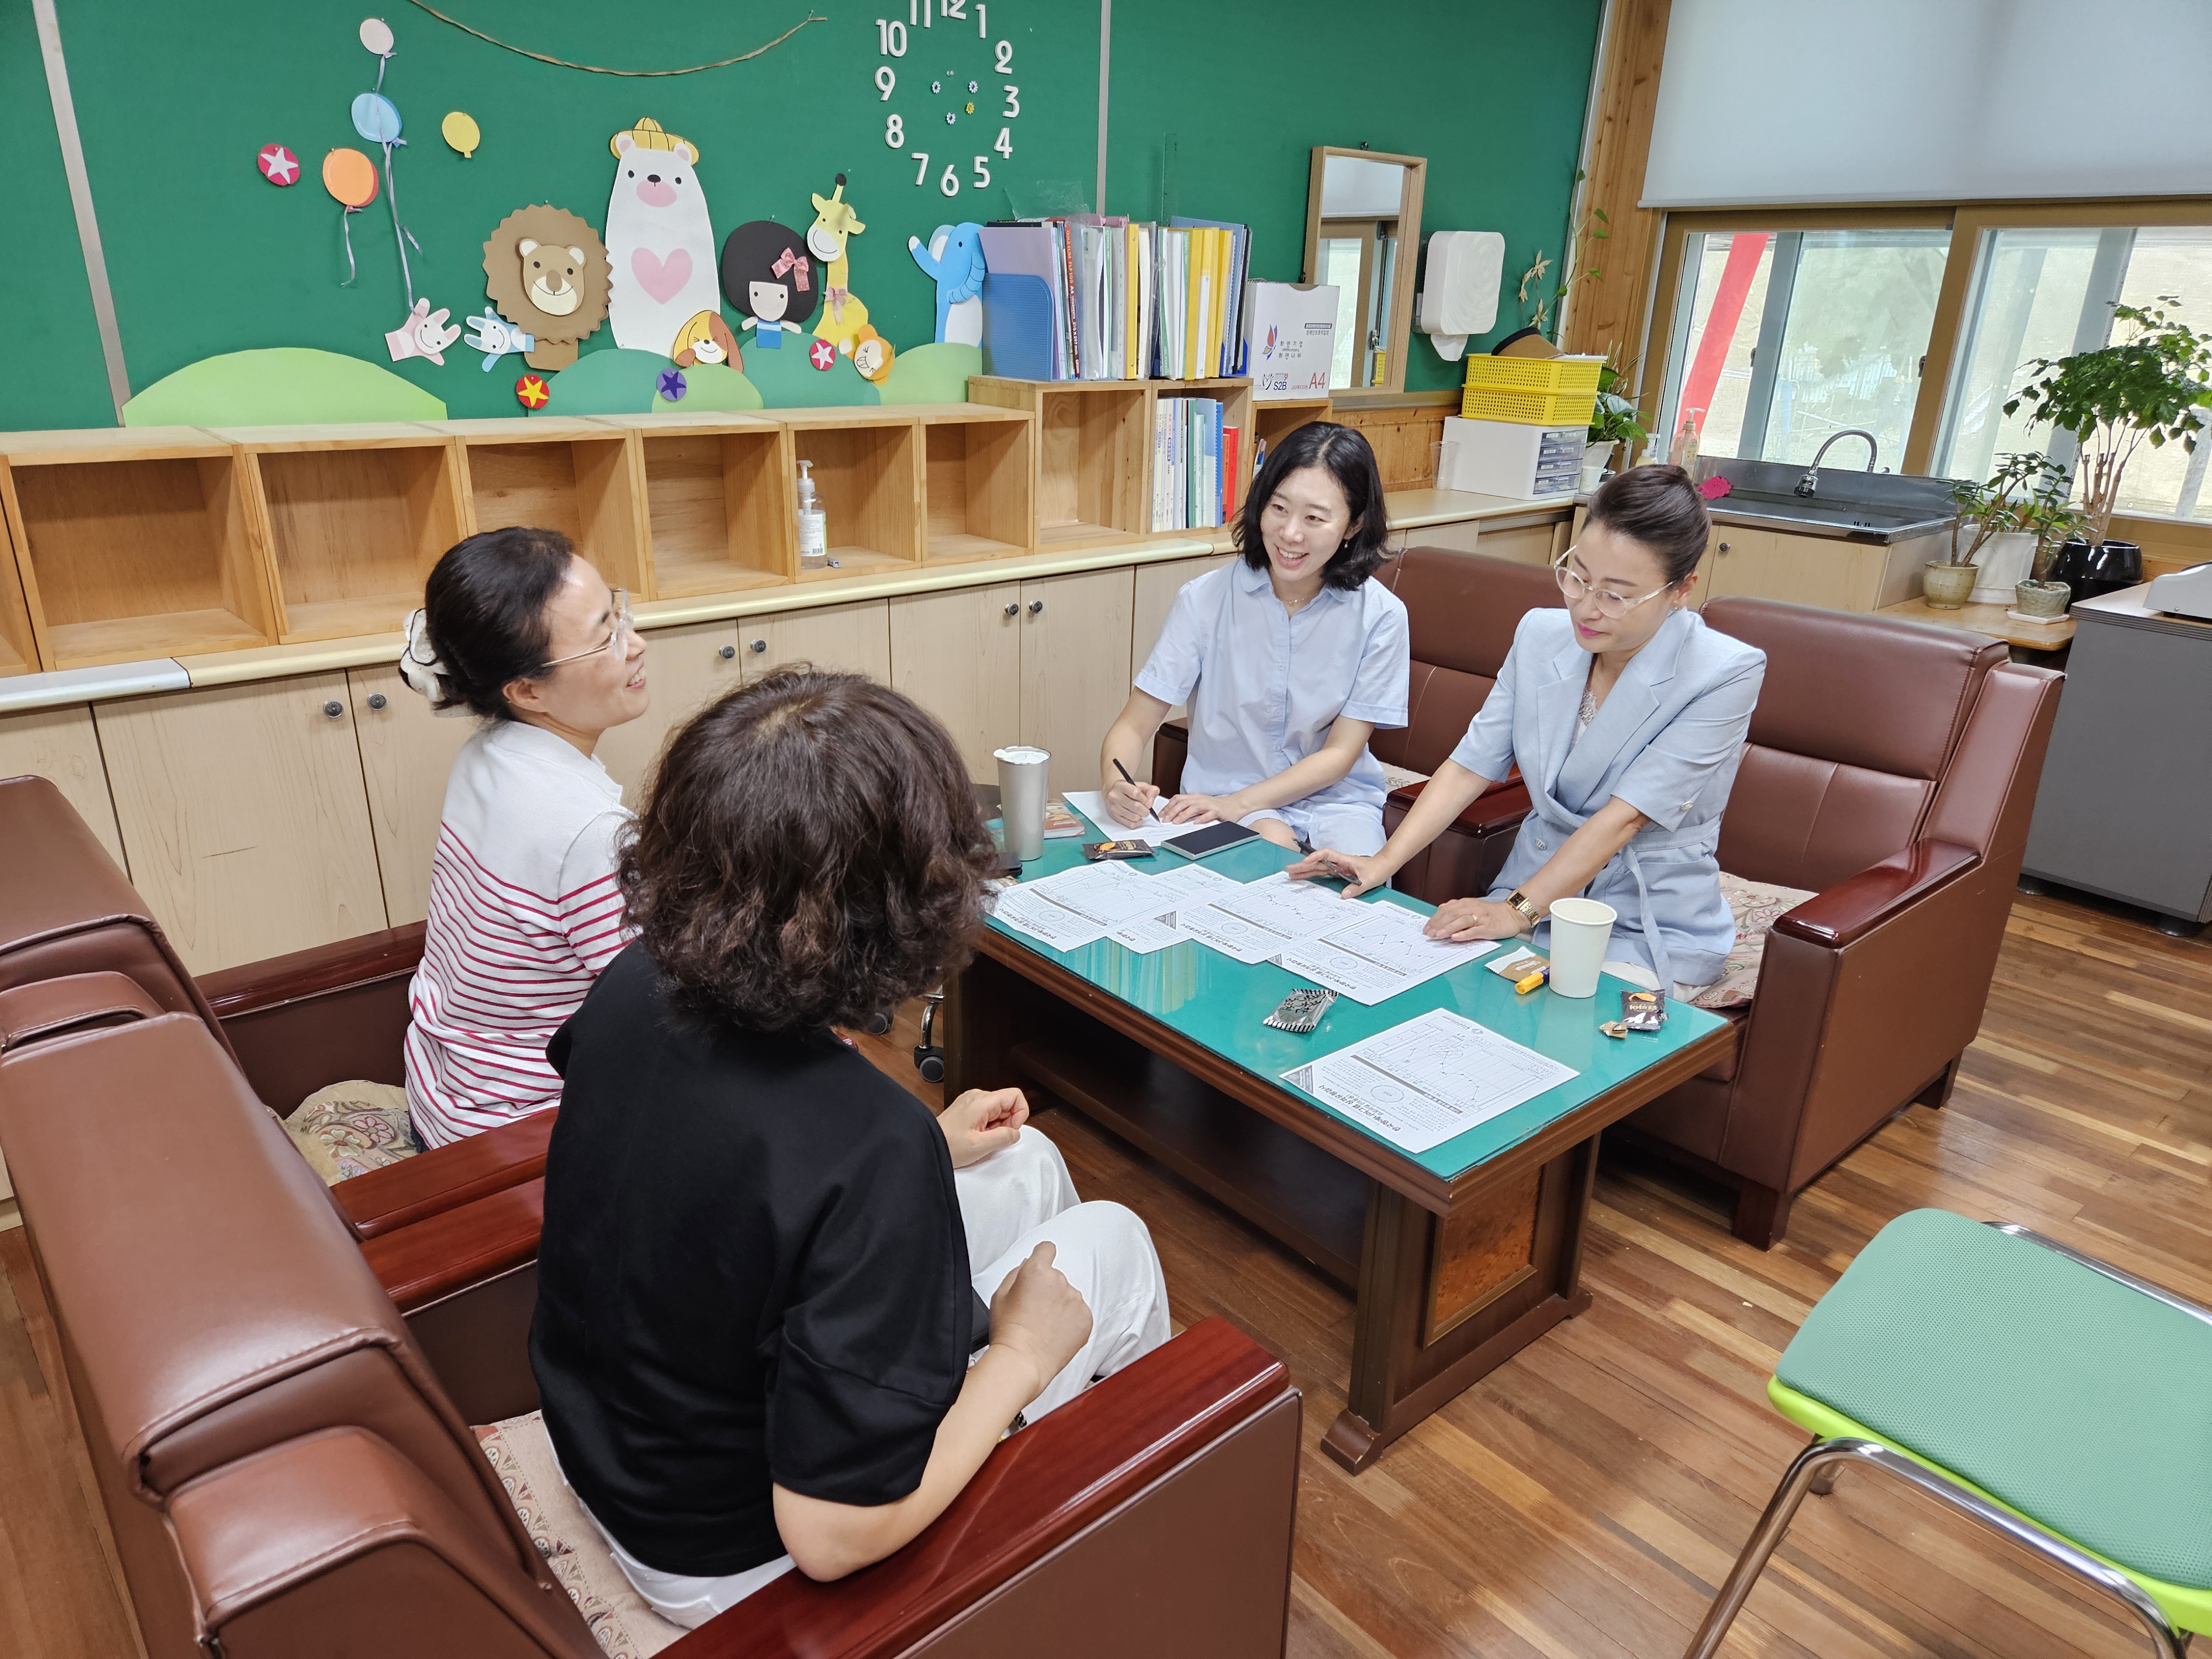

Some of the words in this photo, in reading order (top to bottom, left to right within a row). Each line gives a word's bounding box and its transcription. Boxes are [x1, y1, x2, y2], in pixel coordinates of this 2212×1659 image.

[975, 3, 986, 39] 1
[875, 19, 907, 57] 10
[994, 40, 1013, 75] 2
[874, 65, 896, 101] 9
[1003, 85, 1020, 118] 3
[885, 114, 904, 149] 8
[994, 127, 1013, 159] 4
[911, 153, 929, 186] 7
[941, 164, 959, 197] 6
[973, 156, 990, 189] 5
[1070, 286, 1074, 294] A4
[1274, 381, 1287, 390] S2B
[1308, 372, 1326, 389] A4
